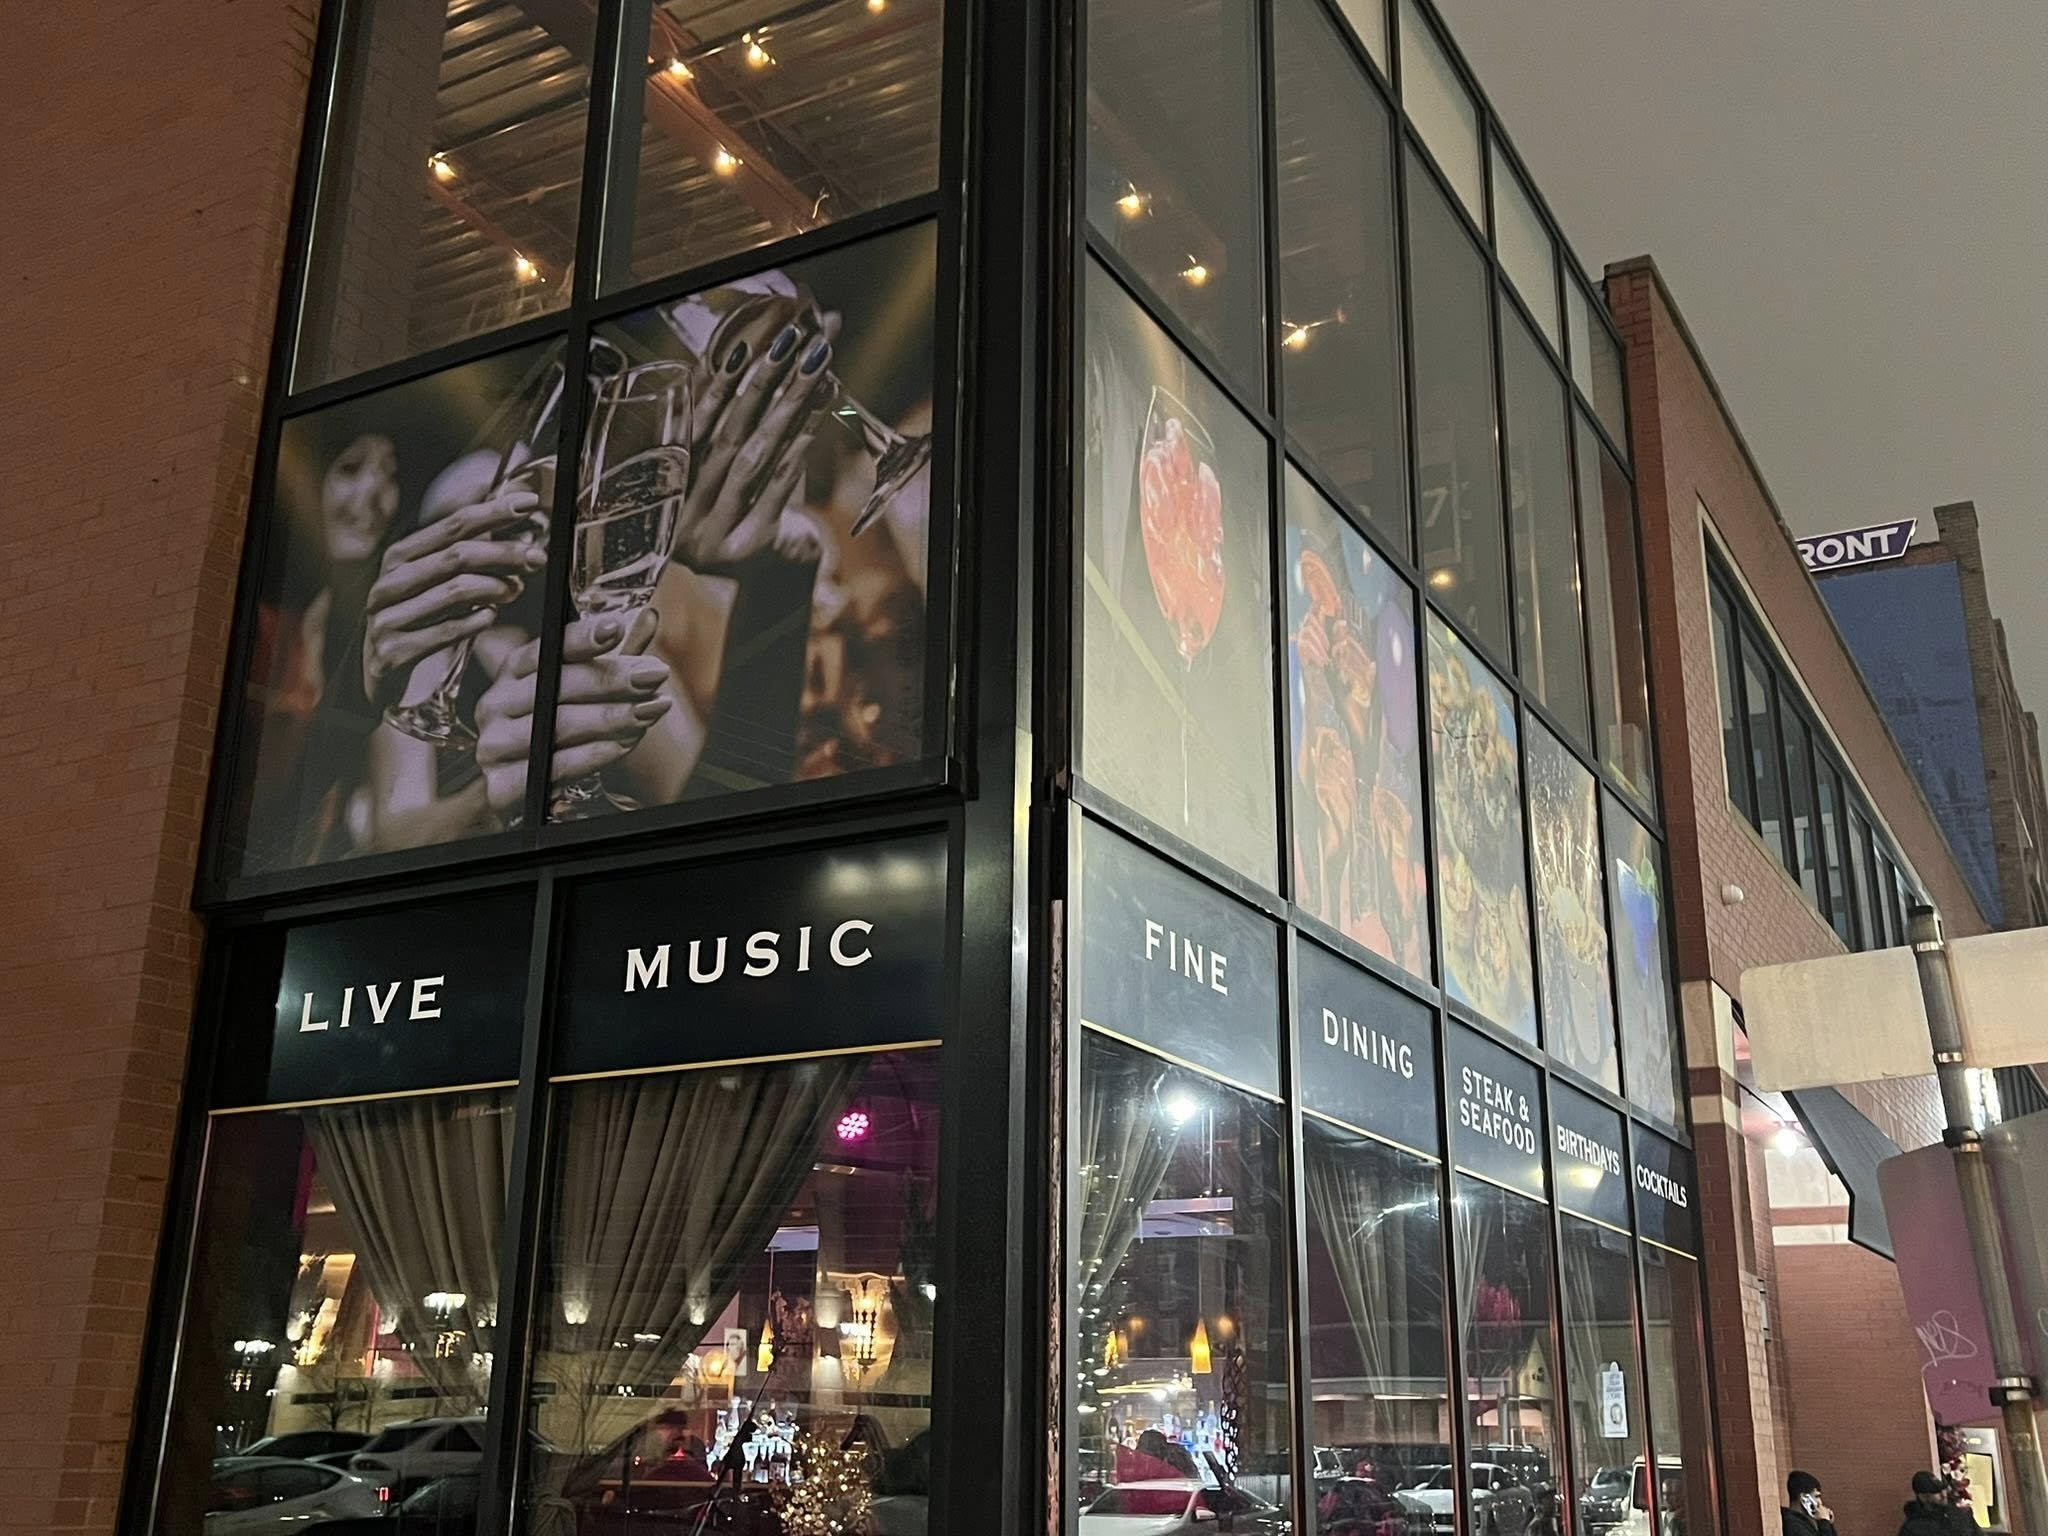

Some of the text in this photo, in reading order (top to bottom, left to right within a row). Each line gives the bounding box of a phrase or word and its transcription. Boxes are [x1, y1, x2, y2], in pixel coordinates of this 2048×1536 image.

[1797, 526, 1899, 567] RONT
[299, 919, 874, 1033] LIVE MUSIC
[1144, 918, 1414, 1080] FINE DINING
[1462, 1065, 1530, 1124] STEAK &
[1459, 1097, 1536, 1155] SEAFOOD
[1556, 1125, 1621, 1176] BIRTHDAYS
[1636, 1164, 1688, 1209] COCKTAILS
